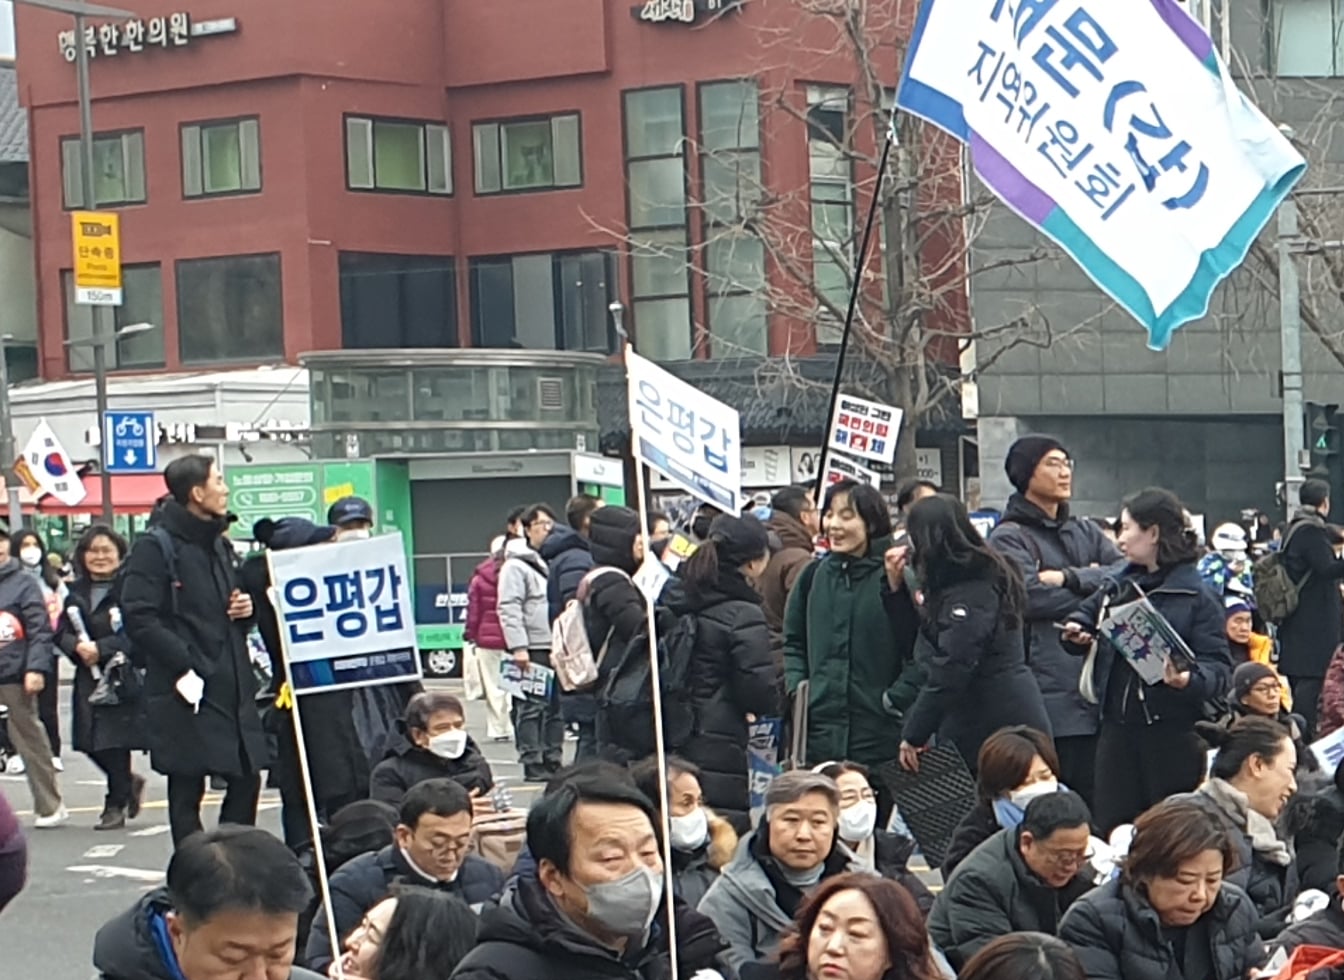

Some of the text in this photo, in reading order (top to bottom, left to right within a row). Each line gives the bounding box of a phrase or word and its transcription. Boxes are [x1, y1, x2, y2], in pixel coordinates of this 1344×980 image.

[967, 40, 1136, 221] 지역위원회
[636, 379, 732, 474] 은평갑
[284, 564, 404, 644] 은평갑
